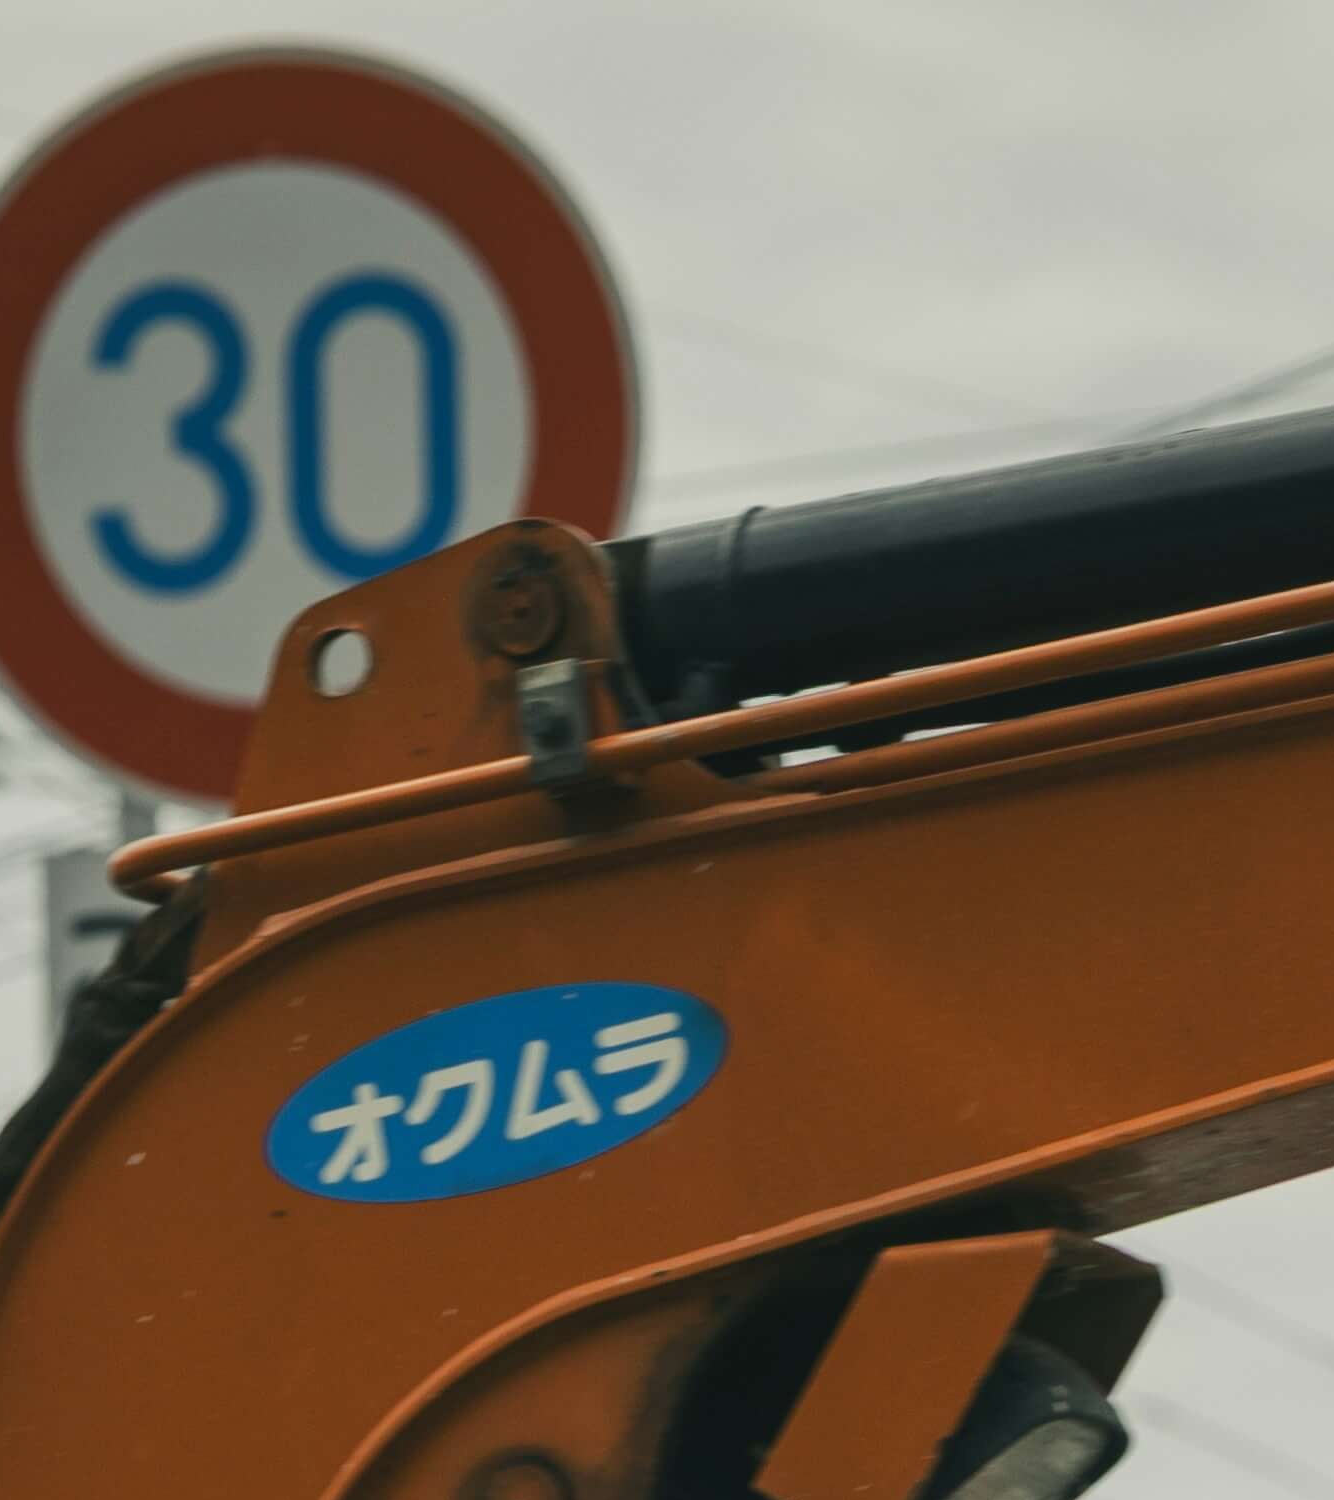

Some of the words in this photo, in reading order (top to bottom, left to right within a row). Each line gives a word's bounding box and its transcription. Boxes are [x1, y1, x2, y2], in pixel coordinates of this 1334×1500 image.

[92, 269, 459, 598] 30
[309, 1012, 689, 1185] オクムラ
